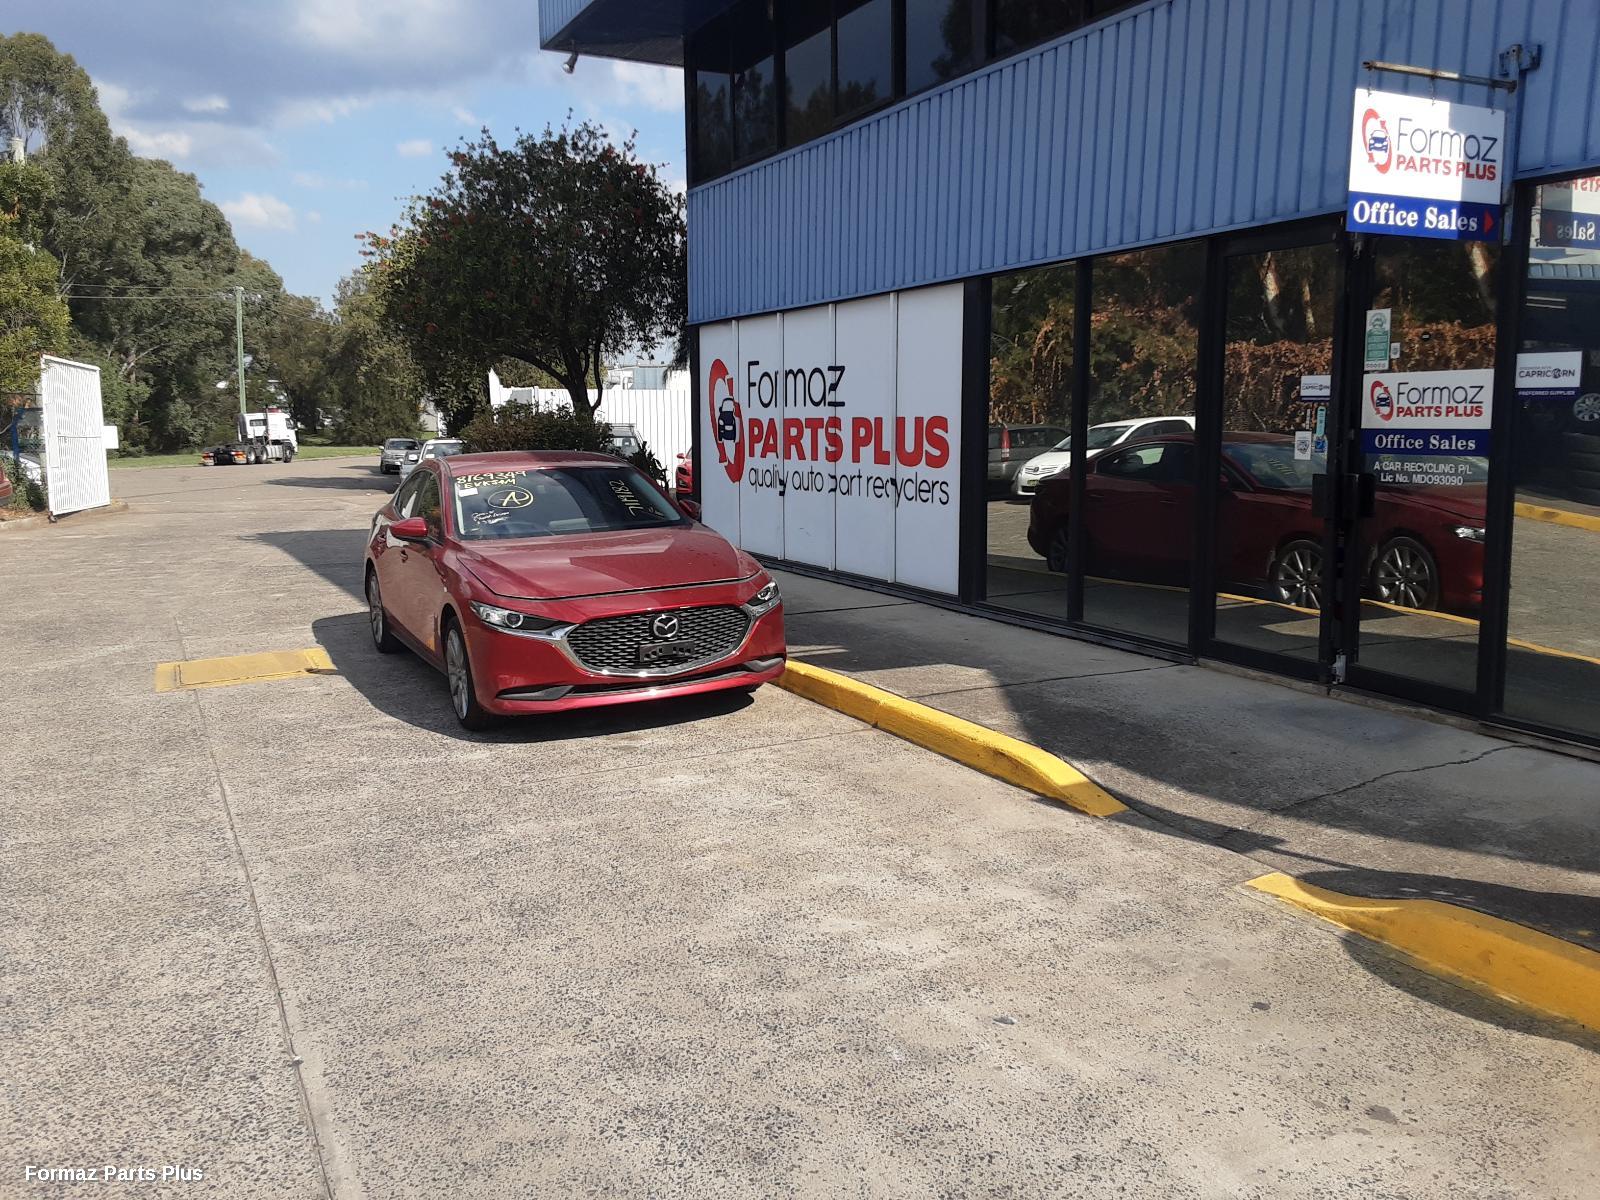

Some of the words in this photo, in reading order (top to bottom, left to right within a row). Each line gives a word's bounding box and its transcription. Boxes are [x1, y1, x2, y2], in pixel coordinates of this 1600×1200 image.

[1397, 117, 1498, 163] Formaz
[1396, 154, 1452, 176] PARTS
[1456, 161, 1497, 181] PLUS
[1353, 201, 1418, 227] Office
[1424, 207, 1478, 232] Sales
[748, 360, 846, 408] Formaz
[1396, 381, 1485, 405] Formaz
[1396, 405, 1443, 418] PARTS
[1446, 405, 1484, 418] PLUS
[748, 416, 843, 463] PARTS
[852, 415, 950, 469] PLUS
[1375, 433, 1424, 450] Office
[1429, 434, 1476, 451] Sales
[792, 466, 824, 493] auto
[1374, 461, 1381, 471] A
[1383, 462, 1402, 472] CAR
[1404, 462, 1455, 474] RECYCLING
[1380, 473, 1394, 483] Lic
